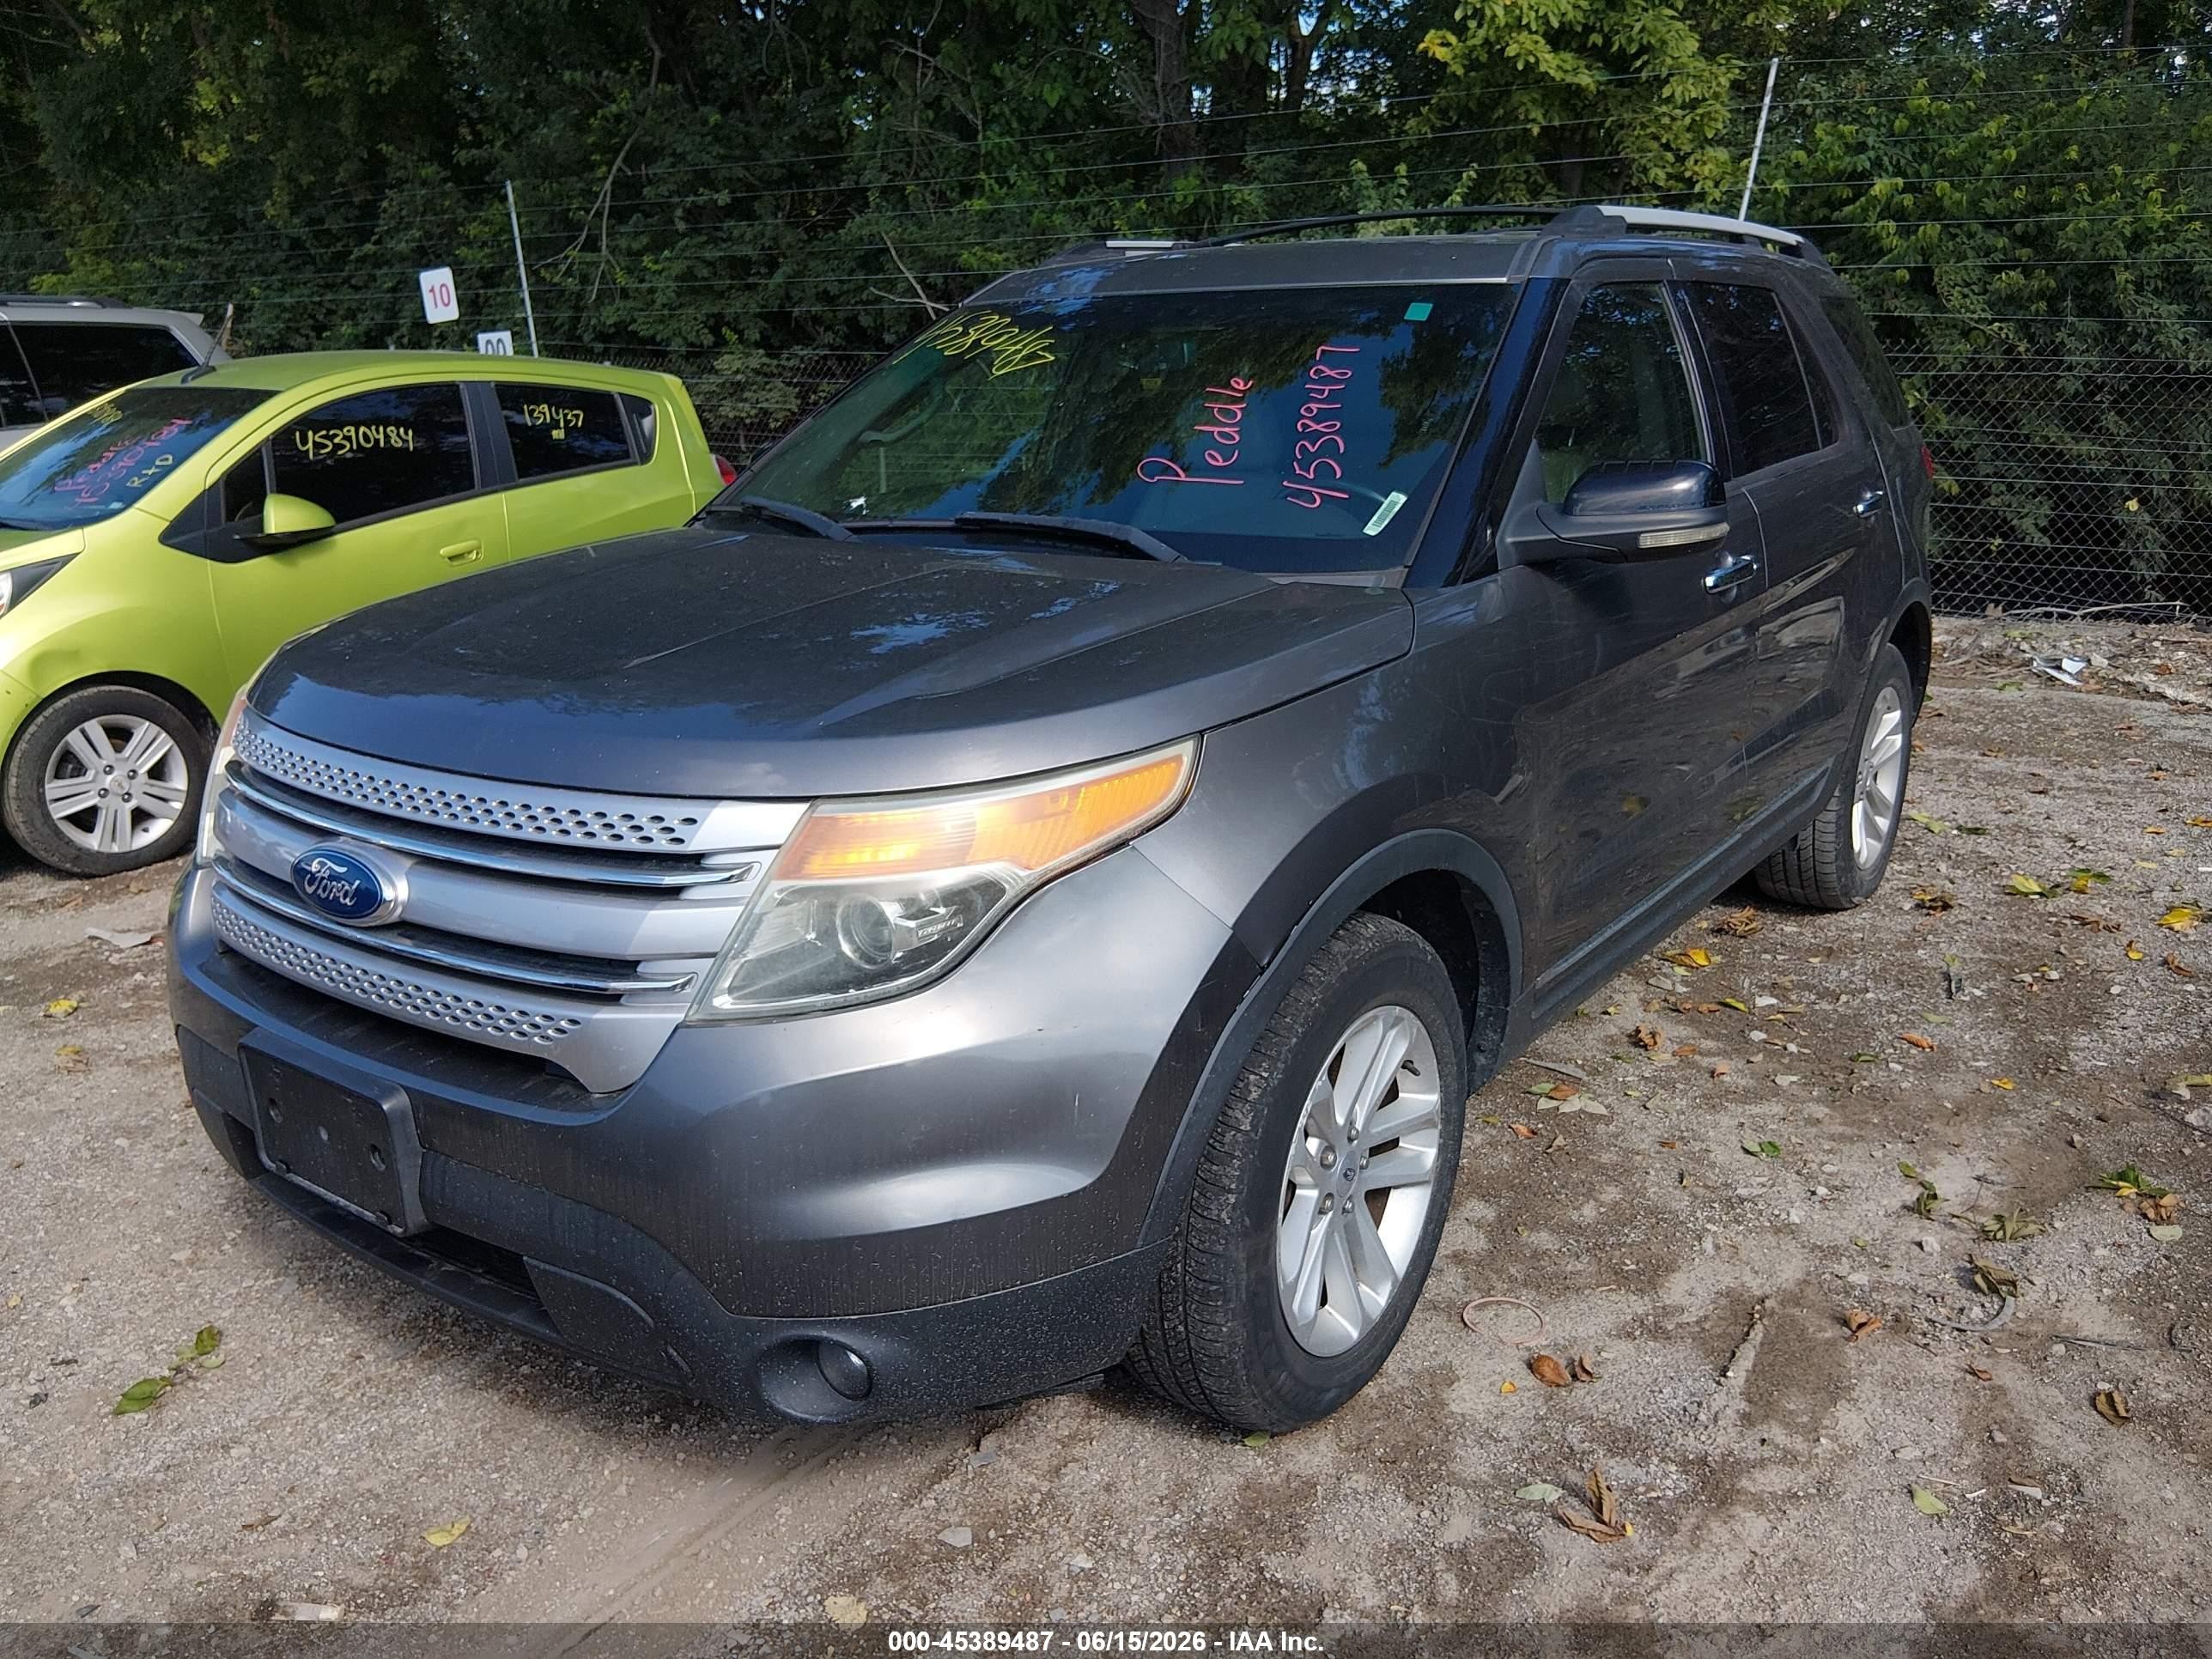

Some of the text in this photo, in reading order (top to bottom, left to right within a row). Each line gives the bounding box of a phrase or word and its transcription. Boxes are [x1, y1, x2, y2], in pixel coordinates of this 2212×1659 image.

[429, 283, 451, 309] 10
[522, 404, 585, 430] 139437
[1136, 376, 1254, 485] Peddle
[1283, 344, 1360, 509] 45389487
[295, 423, 415, 460] 45390484
[301, 857, 361, 906] Ford
